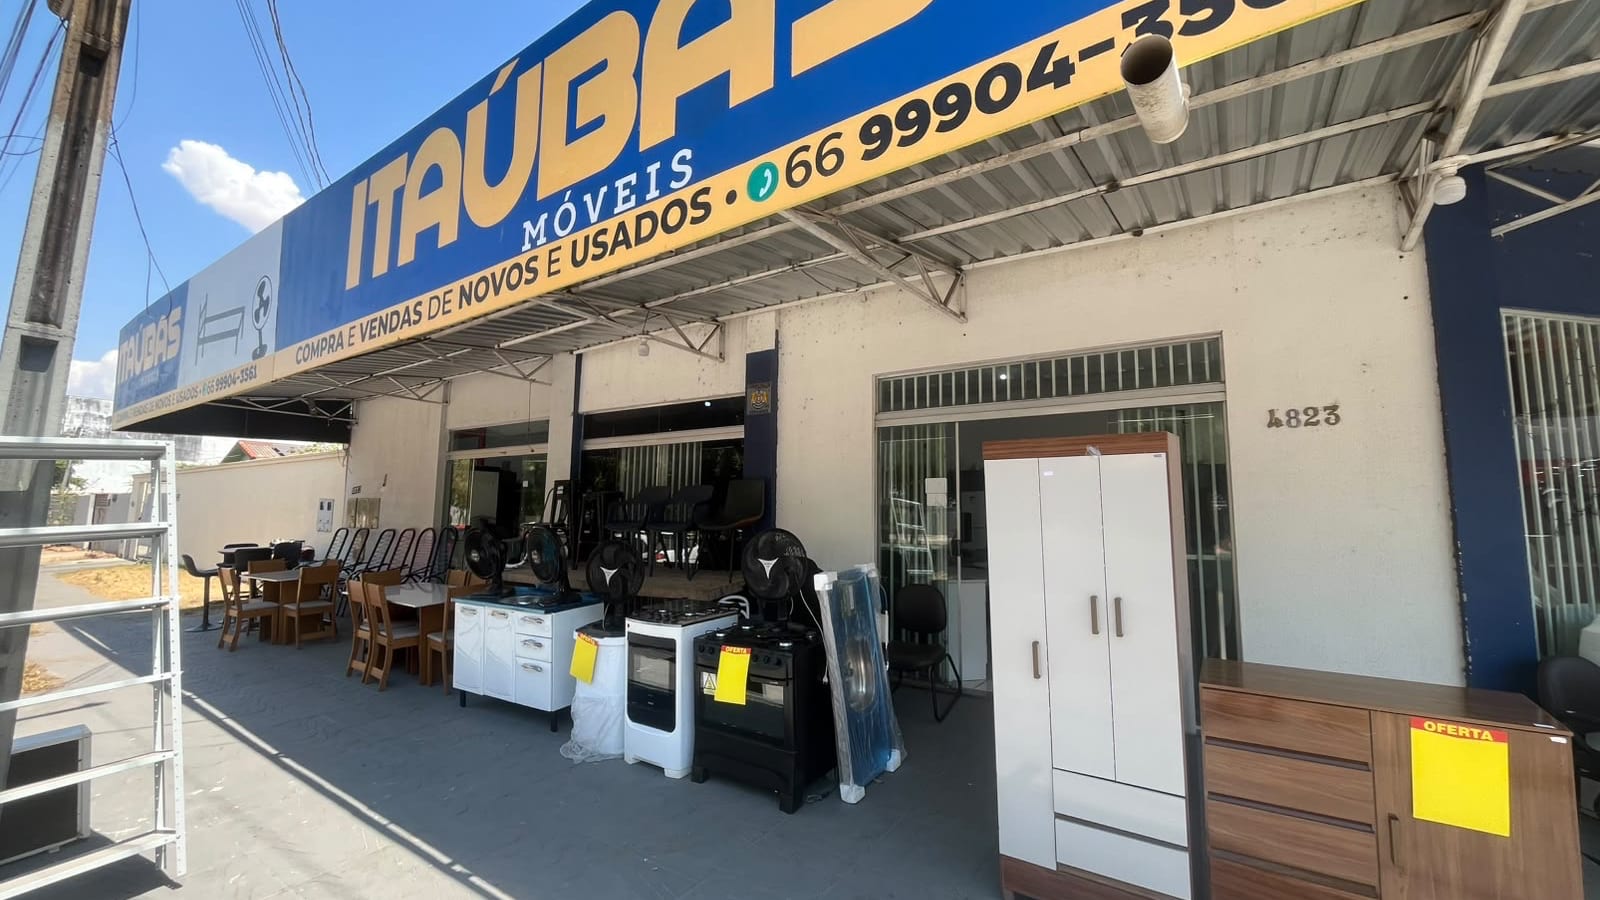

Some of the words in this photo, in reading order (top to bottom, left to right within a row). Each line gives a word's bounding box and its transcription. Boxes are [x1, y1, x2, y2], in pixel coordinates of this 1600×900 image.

[295, 325, 344, 365] COMPRA
[347, 325, 356, 347] E
[359, 301, 423, 343] VENDAS
[426, 289, 454, 321] DE
[458, 255, 539, 310] NOVOS
[547, 246, 562, 278] E
[570, 186, 712, 268] USADOS
[784, 131, 844, 190] 66
[858, 0, 1288, 161] 99904-35
[521, 148, 694, 252] MÓVEIS
[1267, 404, 1341, 428] 4823
[1423, 720, 1494, 742] OFERTA
